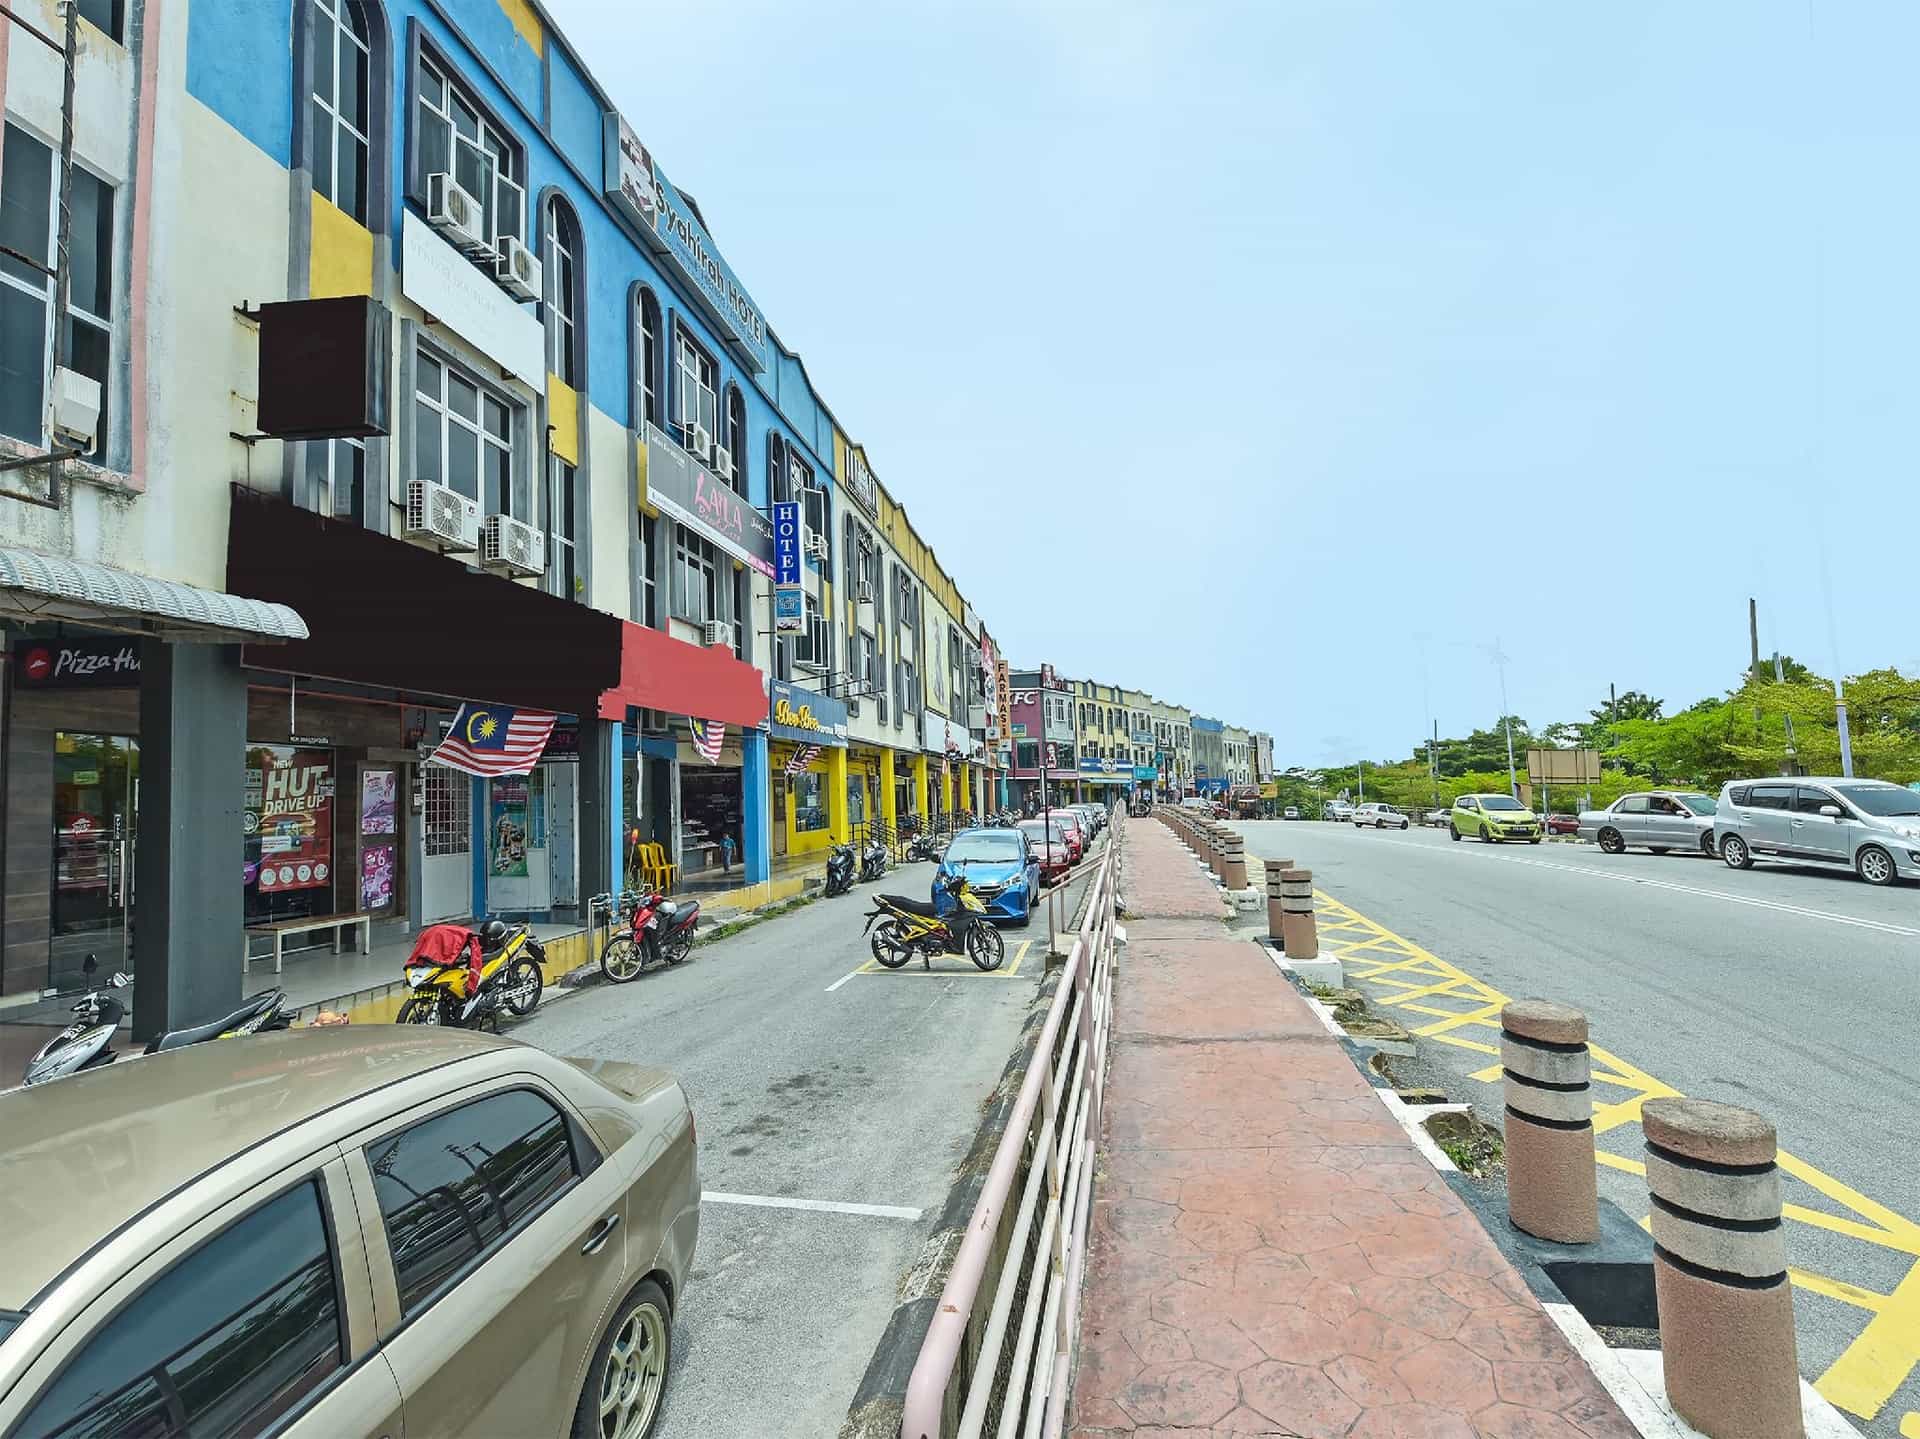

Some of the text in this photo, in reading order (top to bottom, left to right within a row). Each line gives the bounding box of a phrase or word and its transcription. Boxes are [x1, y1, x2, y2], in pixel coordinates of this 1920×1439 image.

[655, 181, 726, 295] Syahirah
[726, 278, 766, 347] HOTEL
[780, 506, 794, 584] HOTEL
[55, 647, 141, 677] Pizza Hu
[273, 759, 294, 769] NEW
[265, 765, 328, 801] HUT
[264, 795, 325, 816] DRIVE UP
